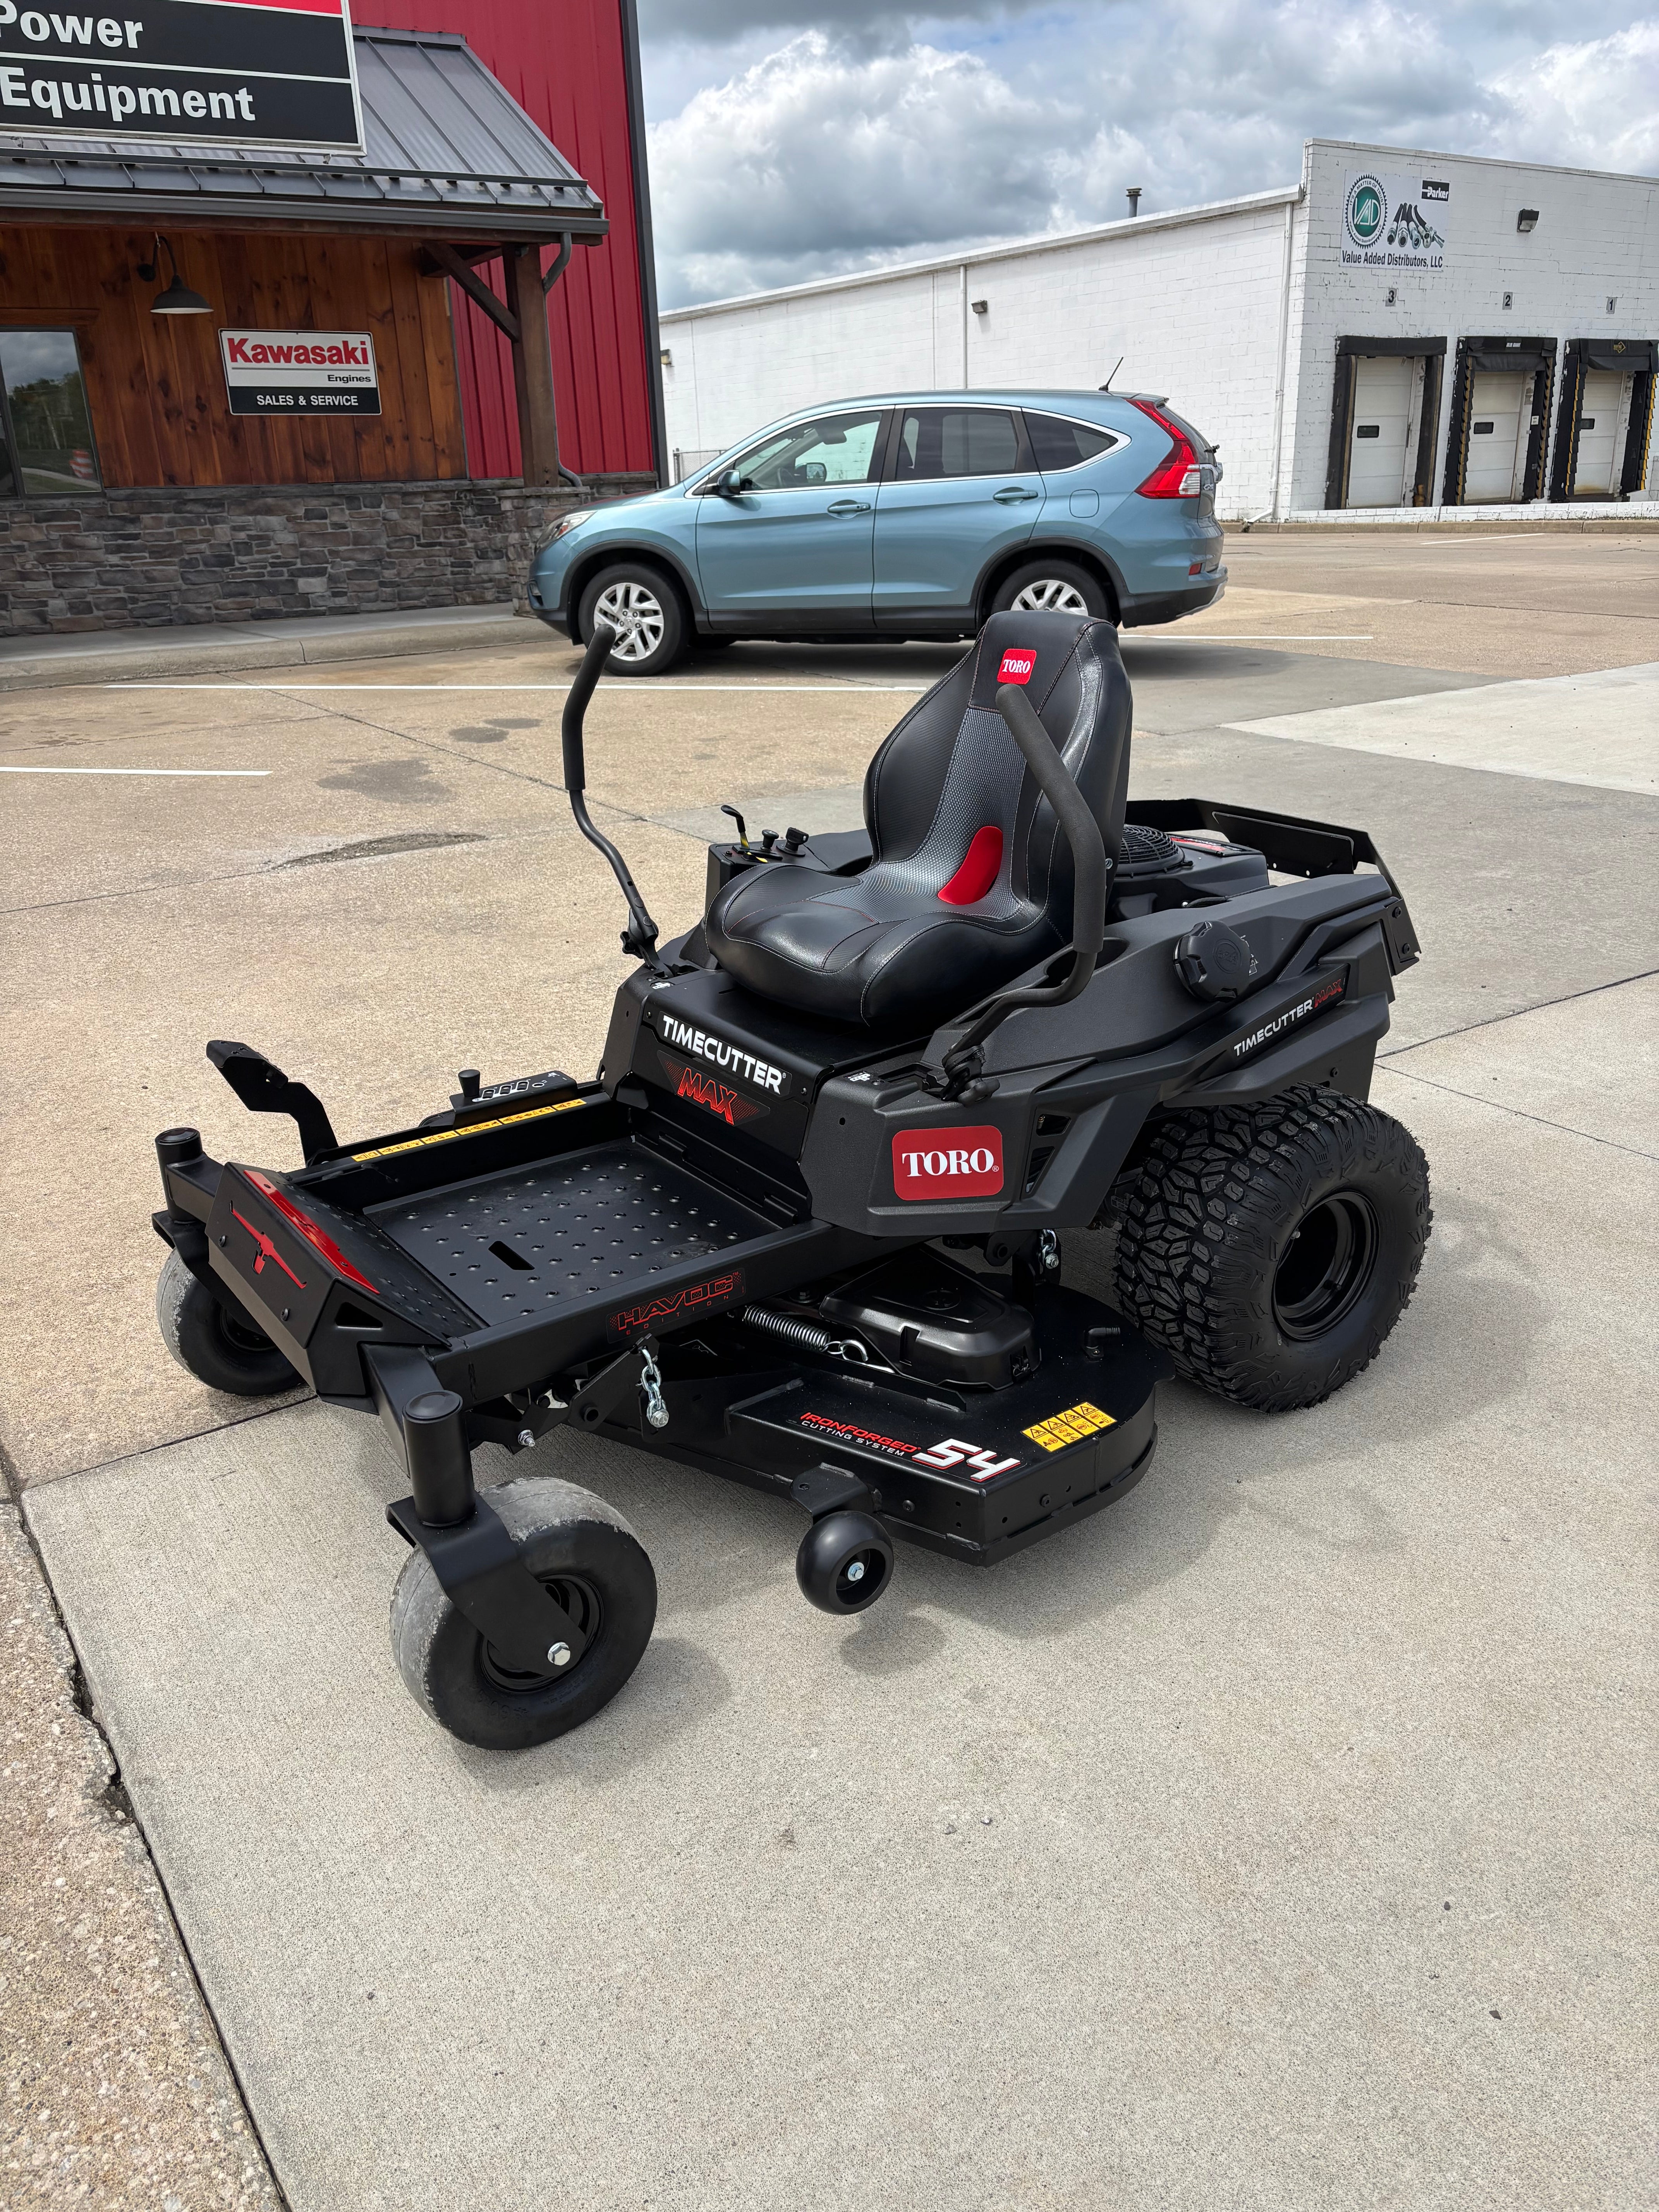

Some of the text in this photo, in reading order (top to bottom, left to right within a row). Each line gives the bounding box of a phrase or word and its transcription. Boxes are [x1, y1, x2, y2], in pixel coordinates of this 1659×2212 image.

[0, 66, 256, 122] Equipment
[1357, 180, 1372, 190] MATTER
[1427, 186, 1449, 199] Parker
[1342, 250, 1443, 270] Value Added Distributors, LLC
[1388, 290, 1395, 303] 3
[1505, 295, 1511, 306] 2
[1609, 299, 1613, 311] 1
[227, 338, 369, 365] Kawasaki
[327, 374, 371, 384] Engines
[256, 395, 359, 406] SALES & SERVICE
[1002, 659, 1031, 674] TORO
[1234, 979, 1343, 1057] TIMECUTTER MAX
[677, 1067, 737, 1125] MAX
[801, 1420, 905, 1457] CUTTING SYSTEM
[912, 1438, 1021, 1483] 54
